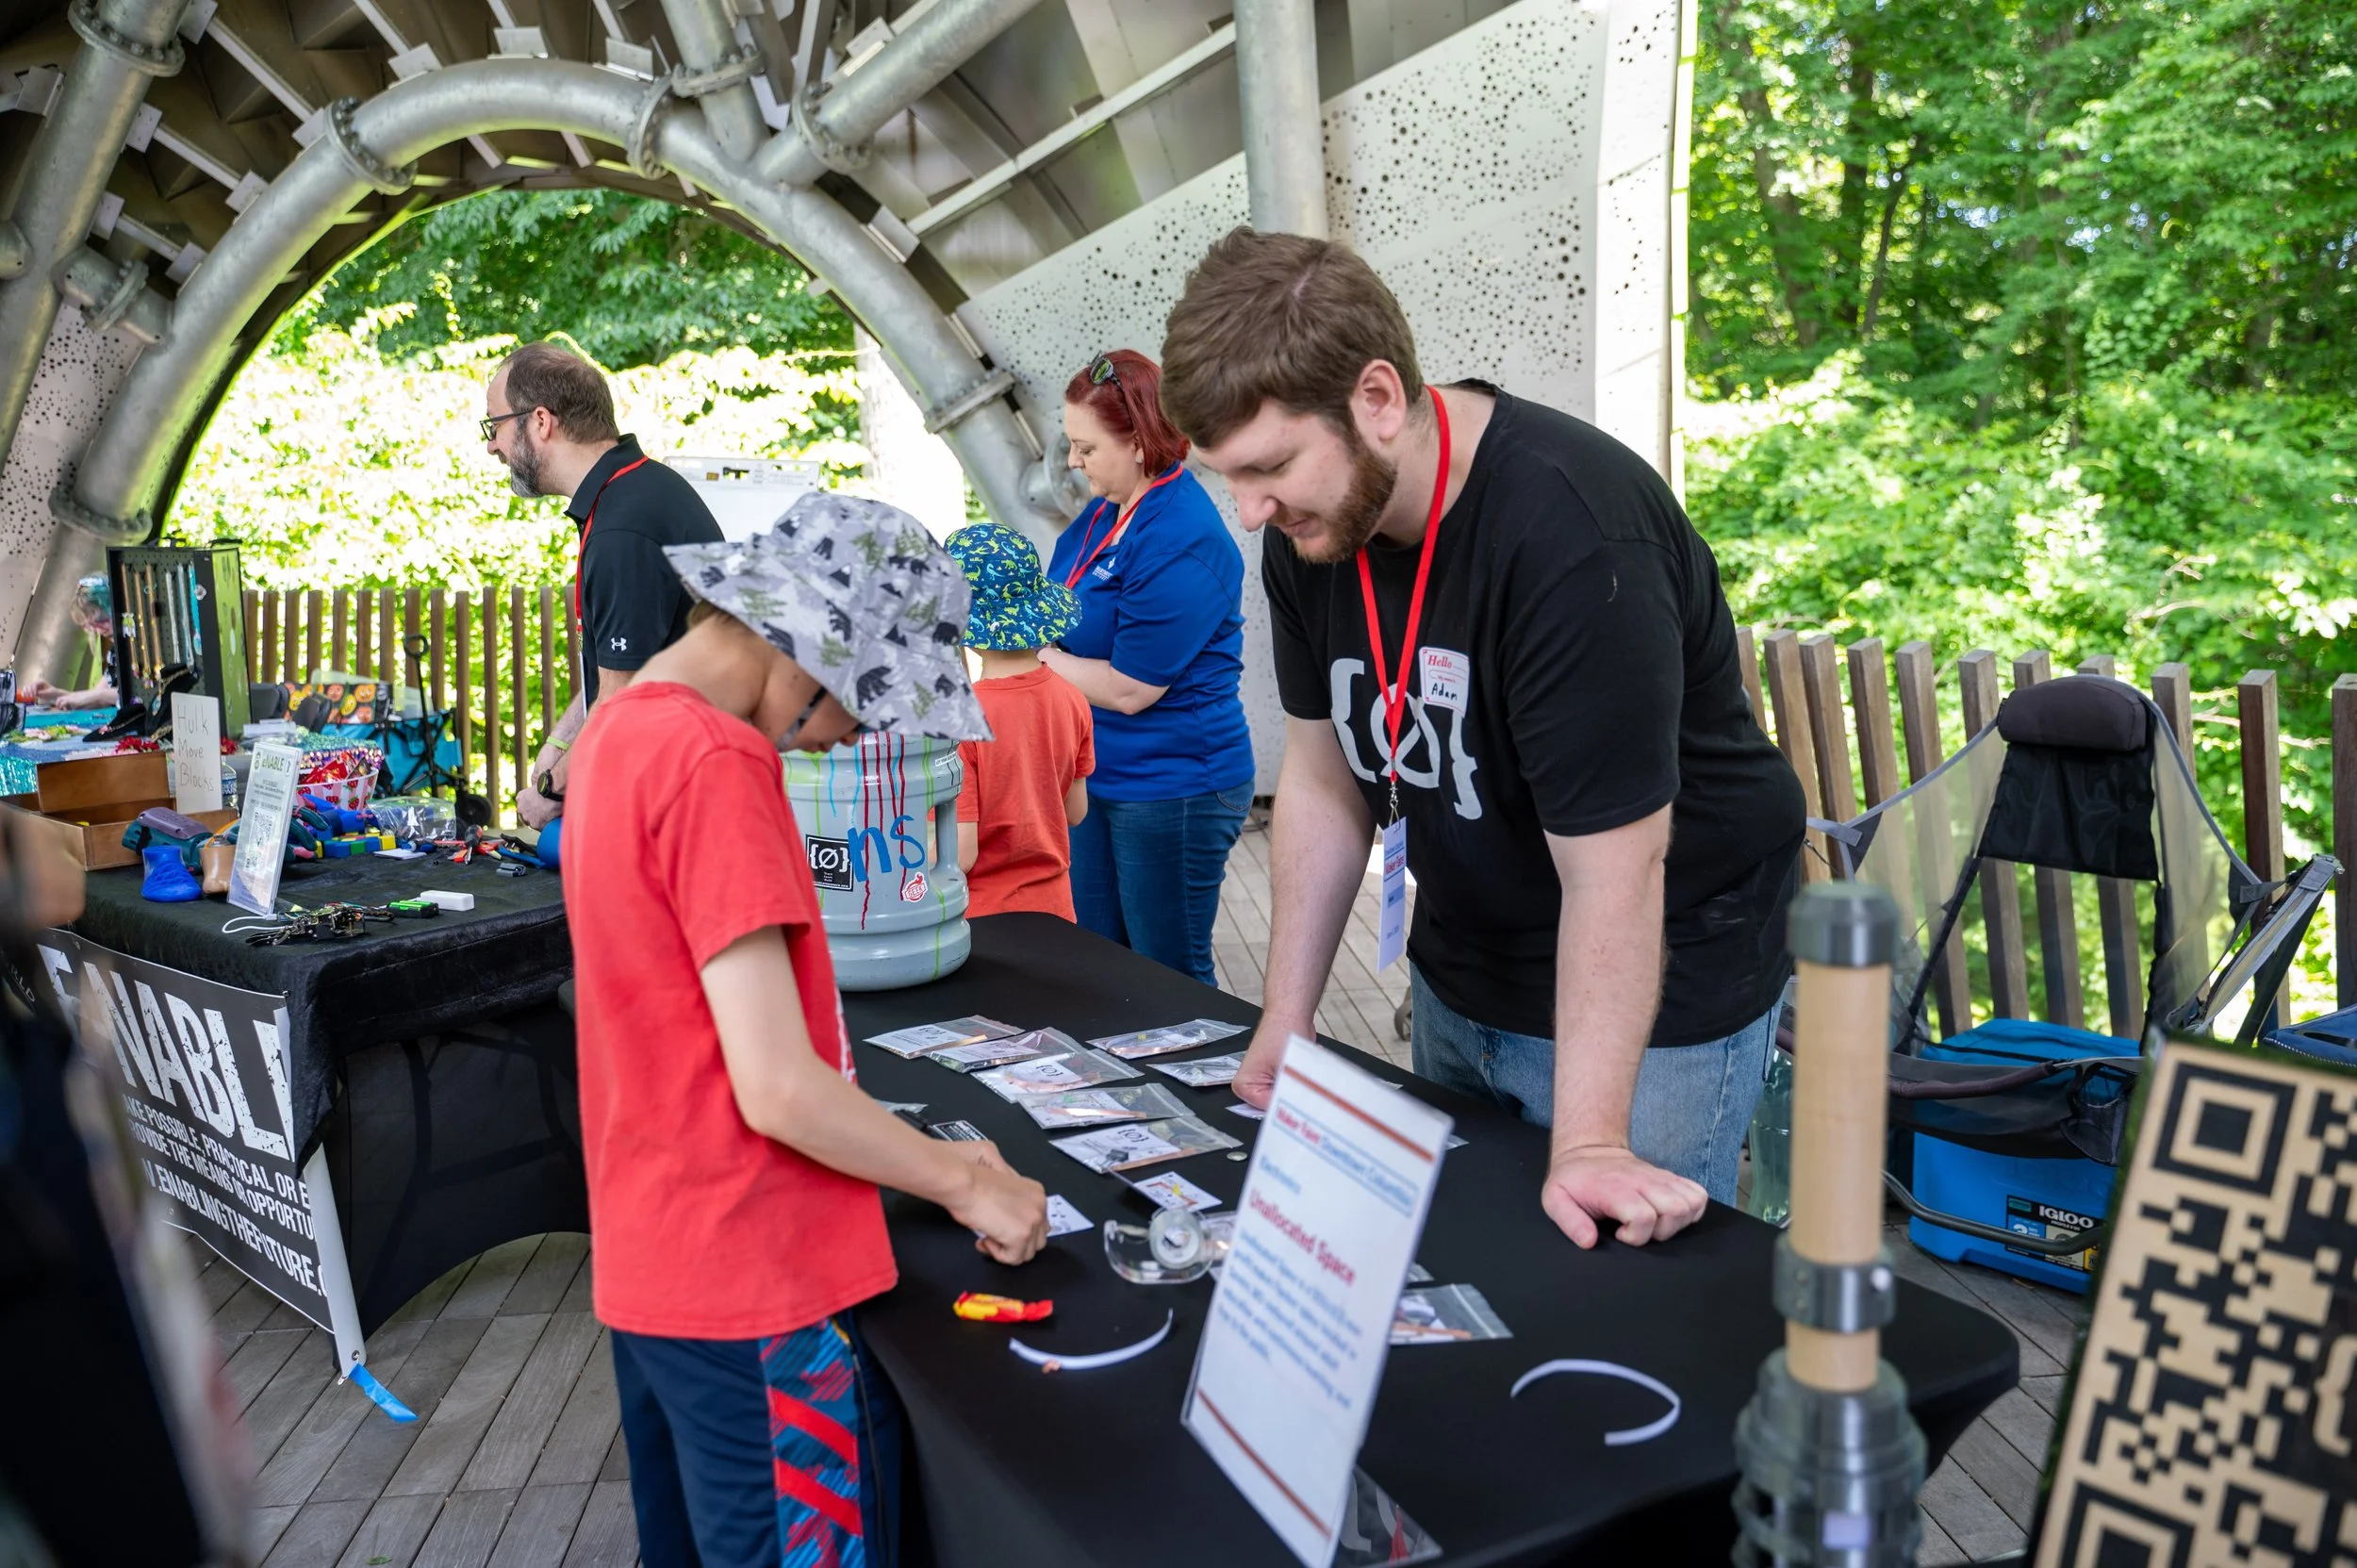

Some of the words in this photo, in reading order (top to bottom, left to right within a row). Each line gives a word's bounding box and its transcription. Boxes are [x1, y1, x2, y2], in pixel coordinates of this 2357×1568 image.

[1427, 654, 1453, 668] Hello
[1431, 683, 1458, 701] Adam
[177, 703, 208, 735] Hulk
[178, 737, 204, 759] Move
[179, 762, 214, 792] Blocks
[143, 1103, 206, 1158] POSSIBLE,
[201, 1133, 274, 1193] PRACTICAL
[274, 1171, 299, 1204] OR
[167, 1137, 195, 1170] THE
[190, 1150, 235, 1194] MEANS
[231, 1176, 250, 1209] OR
[2039, 1205, 2094, 1229] IGLOO
[1249, 1188, 1316, 1255] Unallocated
[1316, 1239, 1356, 1288] Space
